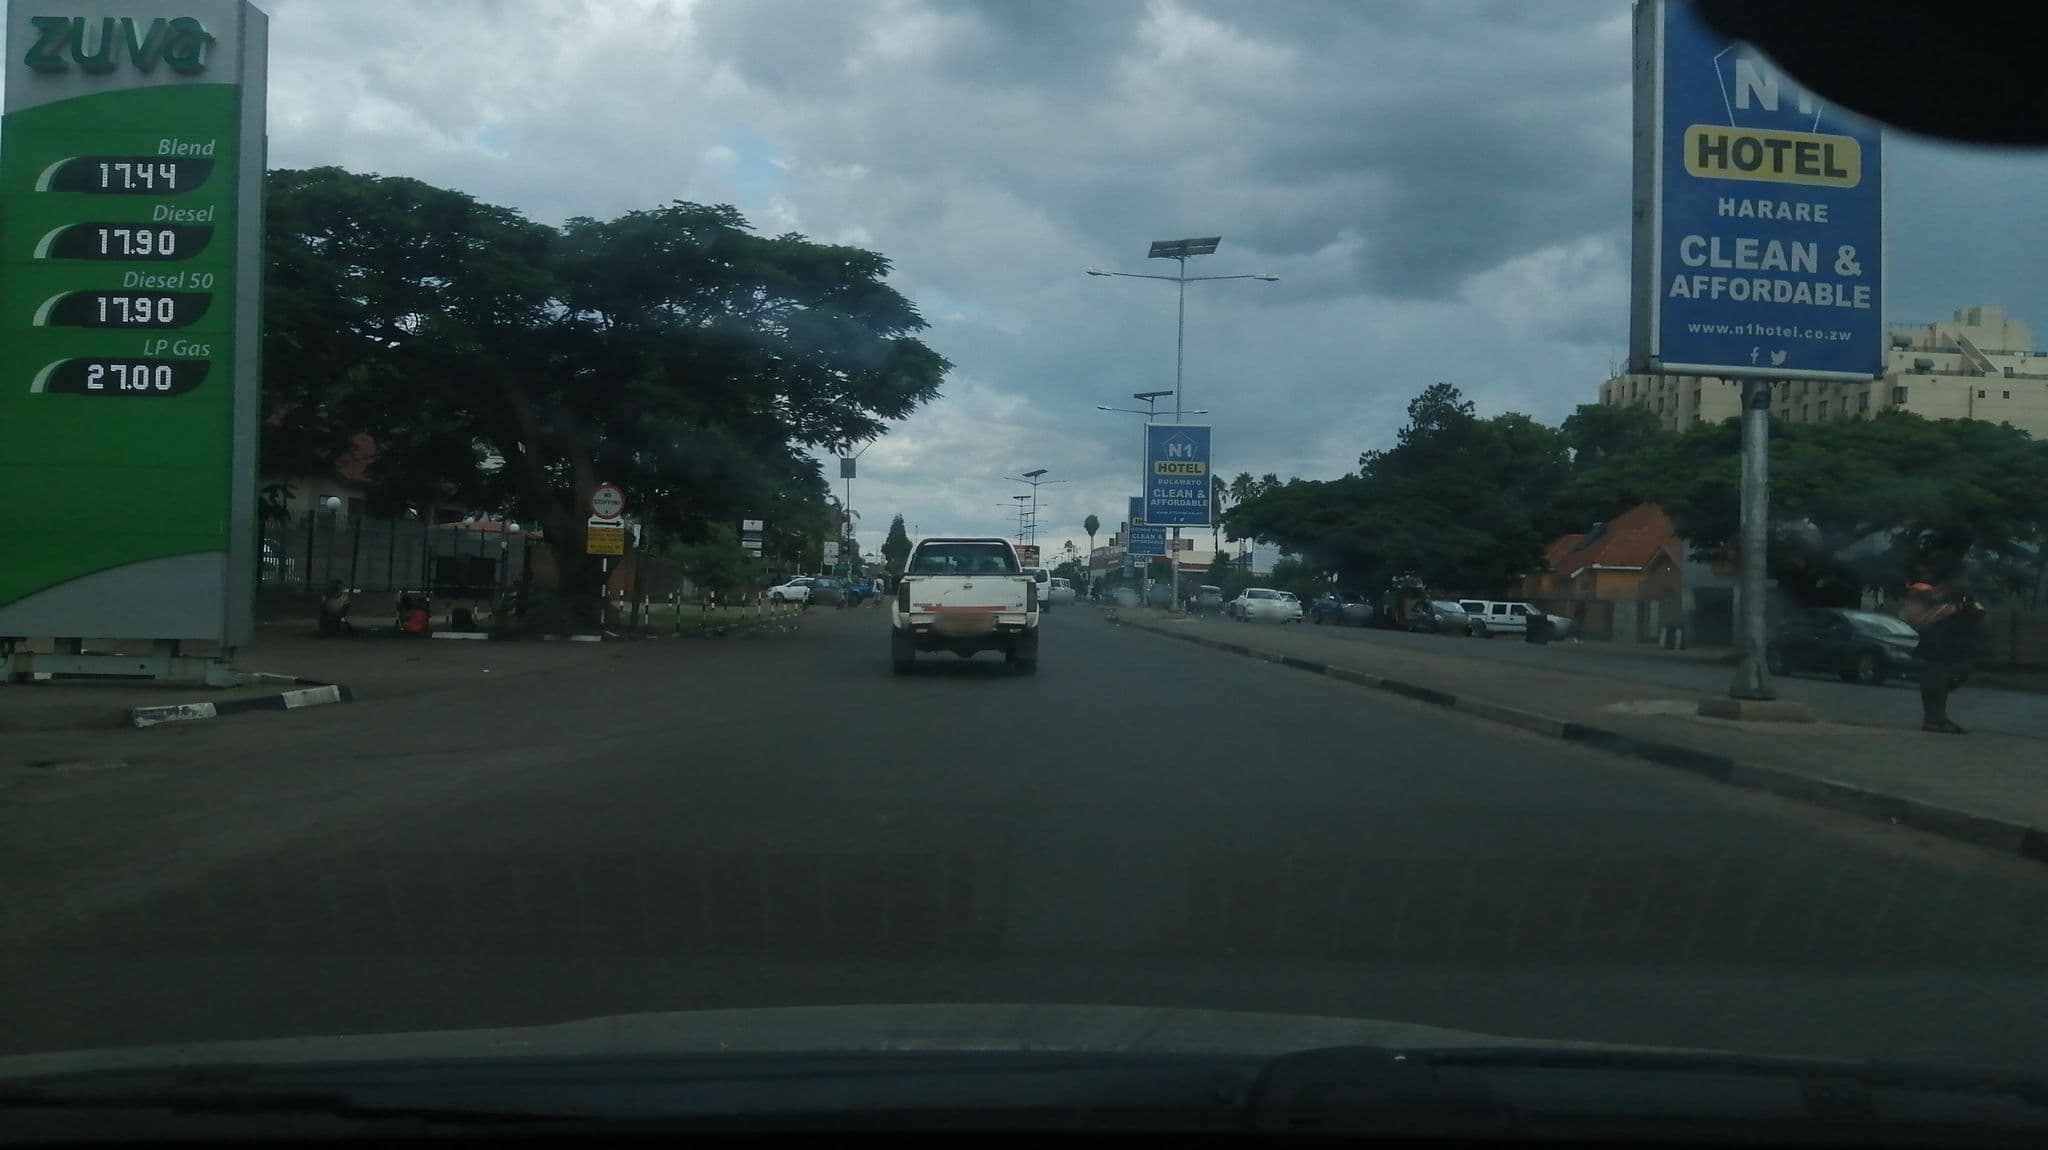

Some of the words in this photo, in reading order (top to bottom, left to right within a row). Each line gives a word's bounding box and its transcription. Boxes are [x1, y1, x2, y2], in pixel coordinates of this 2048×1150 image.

[24, 16, 216, 71] zuva
[158, 139, 215, 155] Blend
[1698, 133, 1848, 179] HOTEL
[99, 163, 177, 189] 17.44
[153, 205, 215, 222] Diesel
[1718, 197, 1829, 224] HARARE
[98, 229, 175, 256] 17.90
[1680, 235, 1818, 274] CLEAN
[1834, 244, 1863, 277] &
[123, 271, 188, 289] Diesel
[191, 272, 214, 289] 50
[1669, 275, 1872, 309] AFFORDABLE
[97, 296, 174, 323] 17.90
[1687, 322, 1852, 341] www.n1hotel.co.zw
[144, 340, 169, 356] LP
[172, 340, 210, 357] Gas
[87, 364, 172, 391] 27.00
[1168, 443, 1192, 457] N1
[1158, 463, 1202, 474] HOTEL
[1158, 478, 1202, 486] BULAWAYO
[1151, 498, 1208, 507] AFFORDABLE
[1153, 488, 1193, 498] CLEAN
[1197, 489, 1206, 499] &
